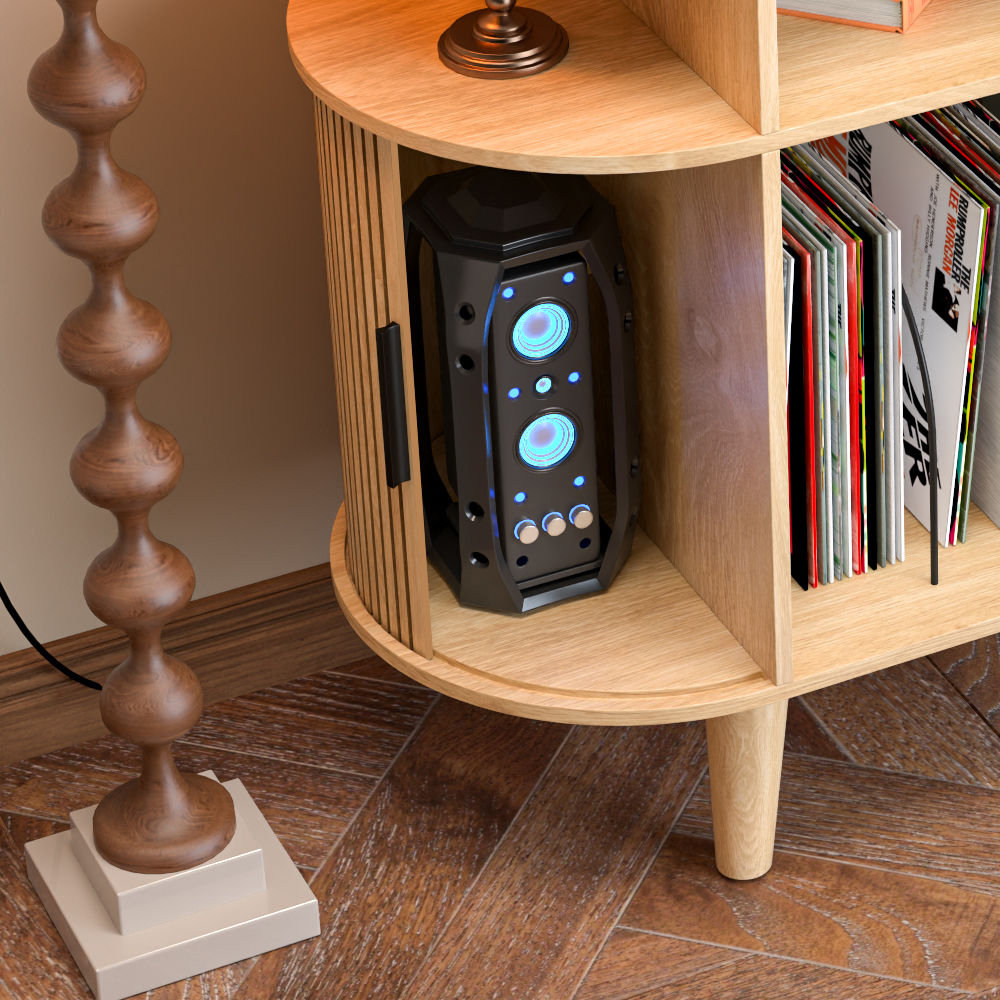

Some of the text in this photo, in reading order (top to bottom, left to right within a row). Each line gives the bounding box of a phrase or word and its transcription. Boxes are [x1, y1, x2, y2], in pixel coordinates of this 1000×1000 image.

[942, 186, 960, 277] LEE MORGAN
[952, 194, 969, 286] RUMPROLLER
[960, 264, 972, 295] THE
